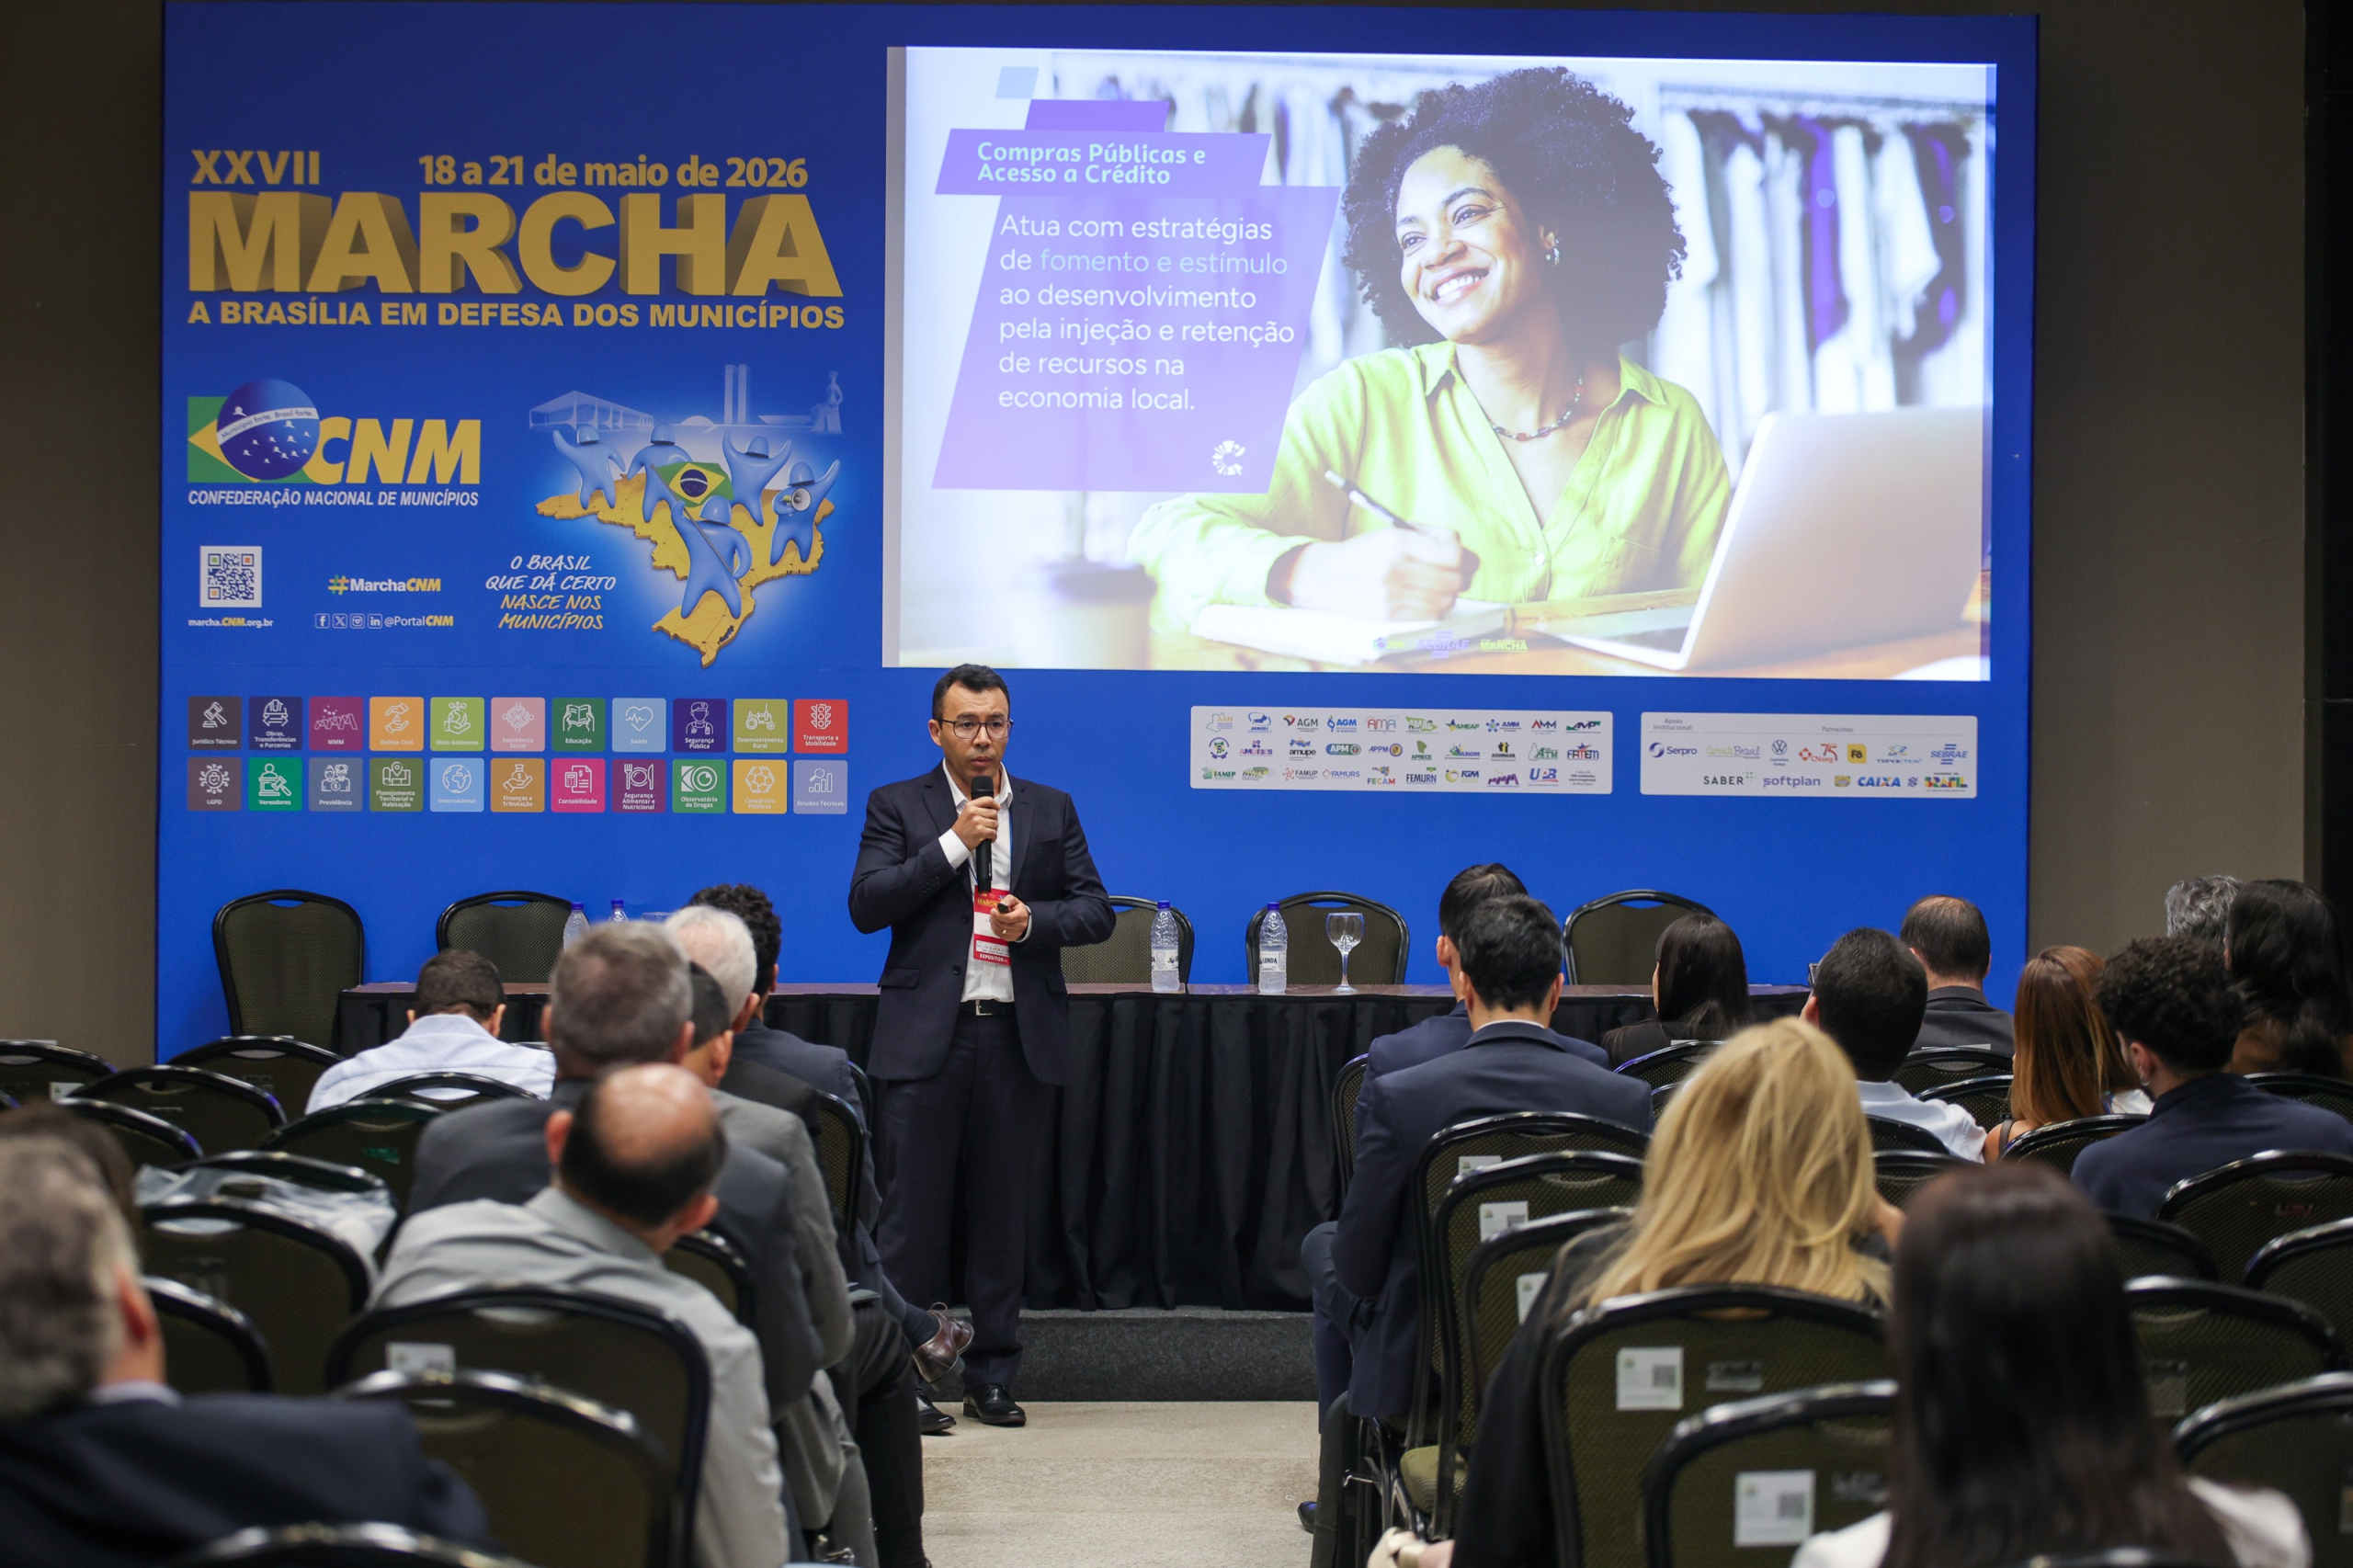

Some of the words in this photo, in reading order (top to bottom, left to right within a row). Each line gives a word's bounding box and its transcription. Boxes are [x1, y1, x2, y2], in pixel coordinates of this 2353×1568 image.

[977, 142, 1081, 165] Compras
[1089, 143, 1187, 165] Públicas
[1193, 149, 1206, 165] e
[190, 150, 320, 185] XXVII
[418, 154, 457, 185] 18
[461, 163, 483, 186] a
[487, 154, 525, 186] 21
[534, 154, 577, 186] de
[585, 154, 670, 186] maio
[676, 155, 720, 187] de
[725, 156, 808, 187] 2026
[977, 164, 1056, 182] Acesso
[1063, 168, 1077, 183] a
[1085, 163, 1170, 184] Crédito
[1000, 214, 1061, 237] Atua
[1068, 220, 1124, 237] com
[1131, 219, 1272, 244] estratégias
[188, 190, 844, 297] MARCHA
[1000, 249, 1031, 270] de
[1040, 249, 1149, 273] fomento
[1157, 256, 1172, 273] e
[1179, 253, 1288, 275] estímulo
[999, 289, 1030, 305] ao
[1038, 284, 1256, 309] desenvolvimento
[188, 302, 210, 324] A
[220, 296, 371, 325] BRASÍLIA
[381, 301, 429, 325] EM
[438, 302, 563, 326] DEFESA
[573, 303, 640, 327] DOS
[649, 299, 845, 329] MUNICÍPIOS
[1000, 318, 1051, 344] pela
[1060, 319, 1152, 346] injeção
[1159, 324, 1174, 341] e
[1182, 321, 1295, 348] retenção
[999, 352, 1031, 373] de
[1039, 358, 1146, 375] recursos
[1155, 359, 1185, 376] na
[998, 387, 1123, 409] economia
[1131, 388, 1195, 411] local.
[275, 410, 293, 418] Brasil
[302, 416, 481, 484] CNM
[188, 488, 302, 508] CONFEDERAÇÃO
[304, 491, 374, 506] NACIONAL
[378, 491, 396, 506] DE
[399, 488, 479, 506] MUNICÍPIOS
[510, 555, 520, 571] O
[529, 555, 592, 571] BRASIL
[328, 574, 441, 596] #MarchaCNM
[485, 575, 523, 592] QUE
[529, 572, 556, 591] DÁ
[562, 575, 616, 591] CERTO
[499, 594, 561, 610] NASCE
[566, 594, 601, 610] NOS
[188, 617, 274, 629] marcha.CNM.org.br
[384, 615, 454, 629] @PortalCNM
[498, 610, 604, 631] MUNICÍPIOS
[1297, 719, 1318, 727] AGM
[1290, 749, 1316, 757] amupe
[1330, 744, 1349, 753] APM
[1666, 746, 1698, 756] Serpro
[1930, 750, 1968, 758] SEBRAE
[1406, 774, 1437, 782] FEMURN
[1703, 776, 1744, 785] SABER
[1763, 776, 1821, 788] softplan
[1858, 777, 1901, 787] CAIXA
